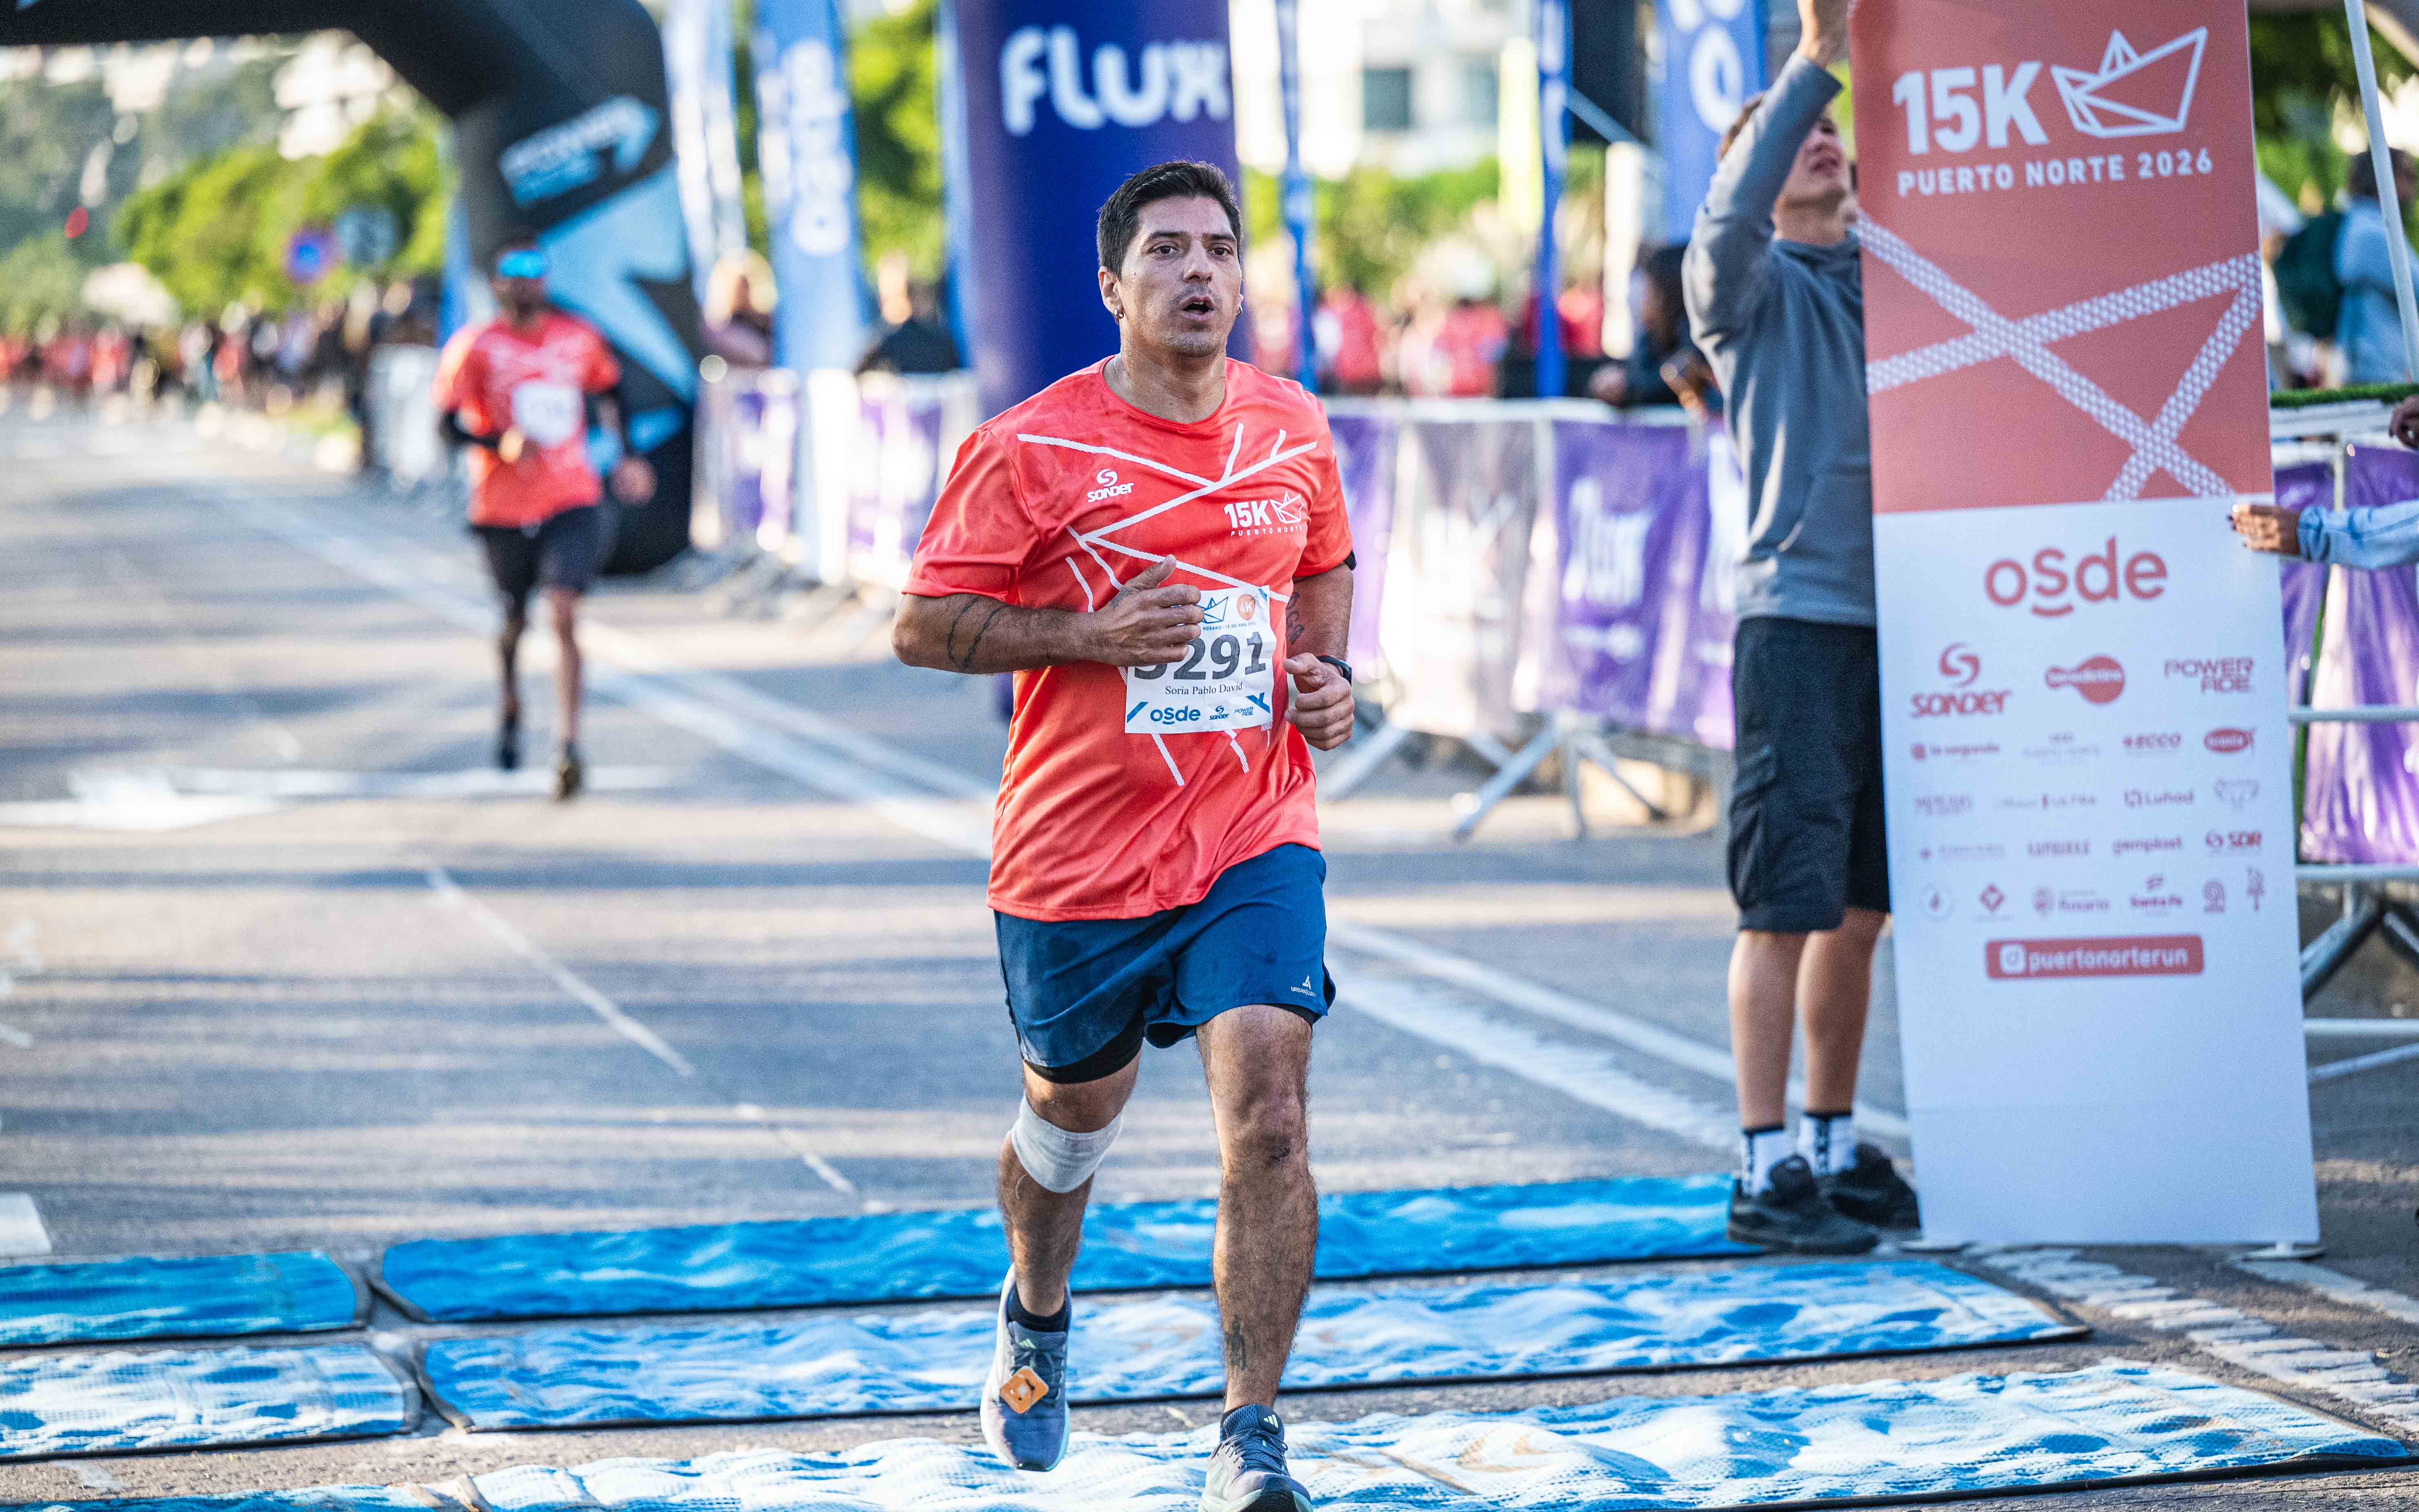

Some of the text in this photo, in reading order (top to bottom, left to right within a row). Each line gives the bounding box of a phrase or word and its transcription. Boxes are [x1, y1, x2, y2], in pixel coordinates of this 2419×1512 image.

[1893, 61, 2049, 155] 15K
[1897, 149, 2213, 197] PUERTO NORTE 2026
[1224, 500, 1272, 528] 15K
[1231, 527, 1273, 536] PUERTO
[1984, 535, 2168, 608] osde
[1165, 682, 1243, 695] Soria Pablo David
[1150, 706, 1201, 722] osde
